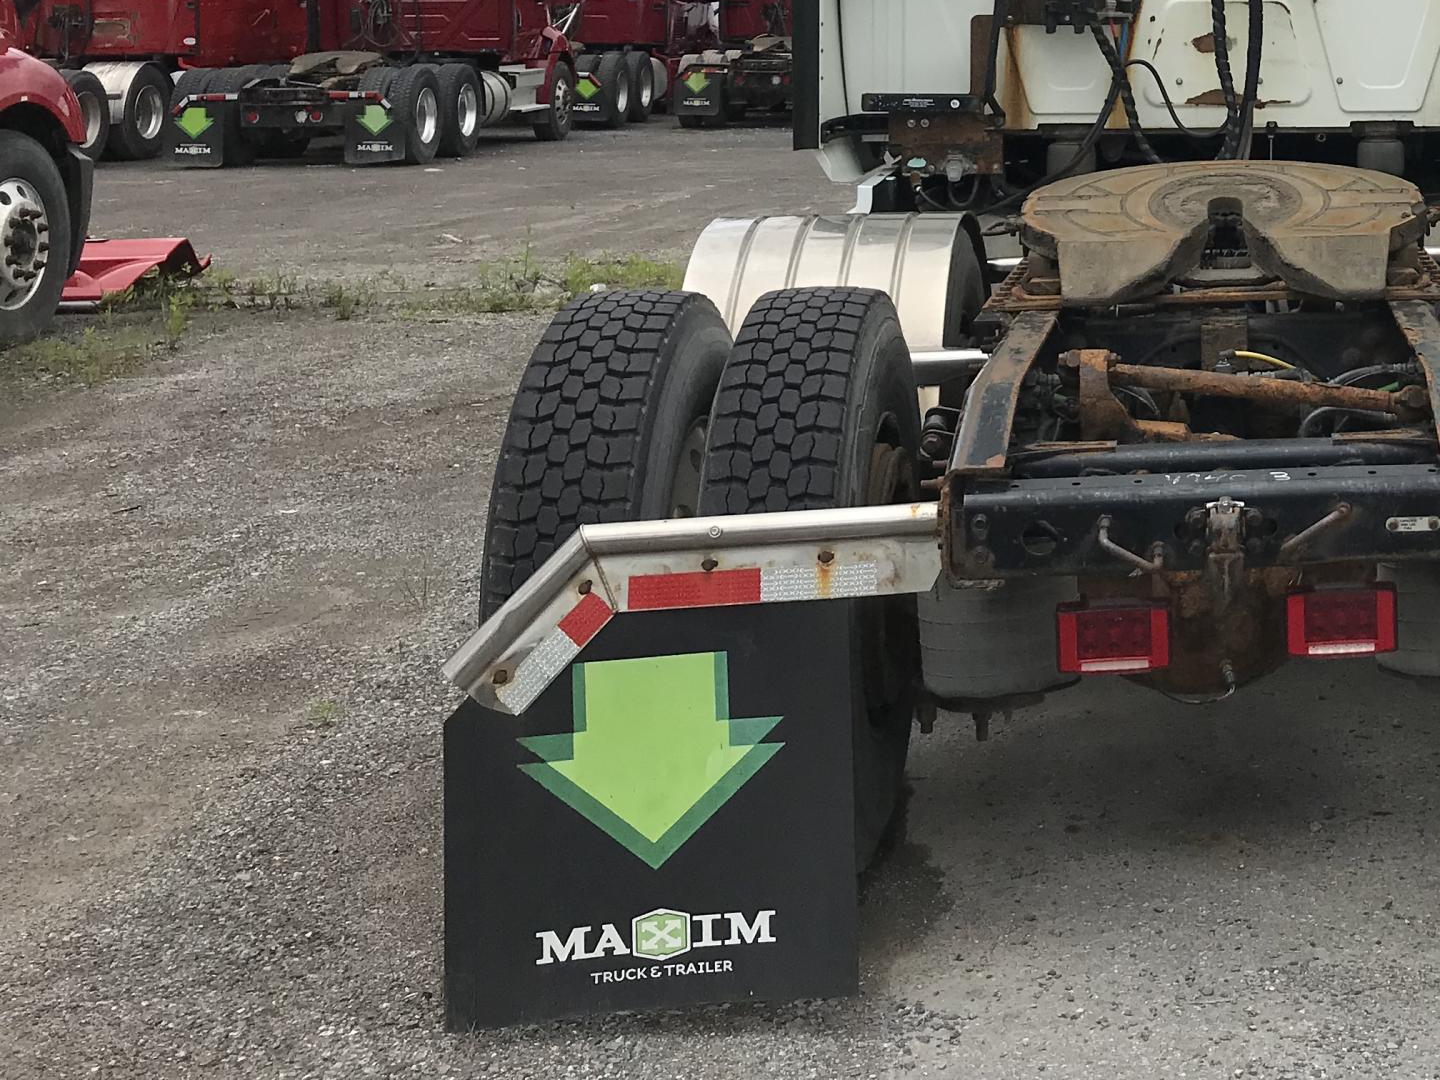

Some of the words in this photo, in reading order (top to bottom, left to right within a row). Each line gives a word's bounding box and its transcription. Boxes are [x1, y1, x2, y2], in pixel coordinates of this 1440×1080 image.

[535, 908, 777, 965] MAXIM
[590, 967, 647, 985] TRUCK
[650, 965, 663, 978] &
[664, 960, 733, 977] TRAILER
